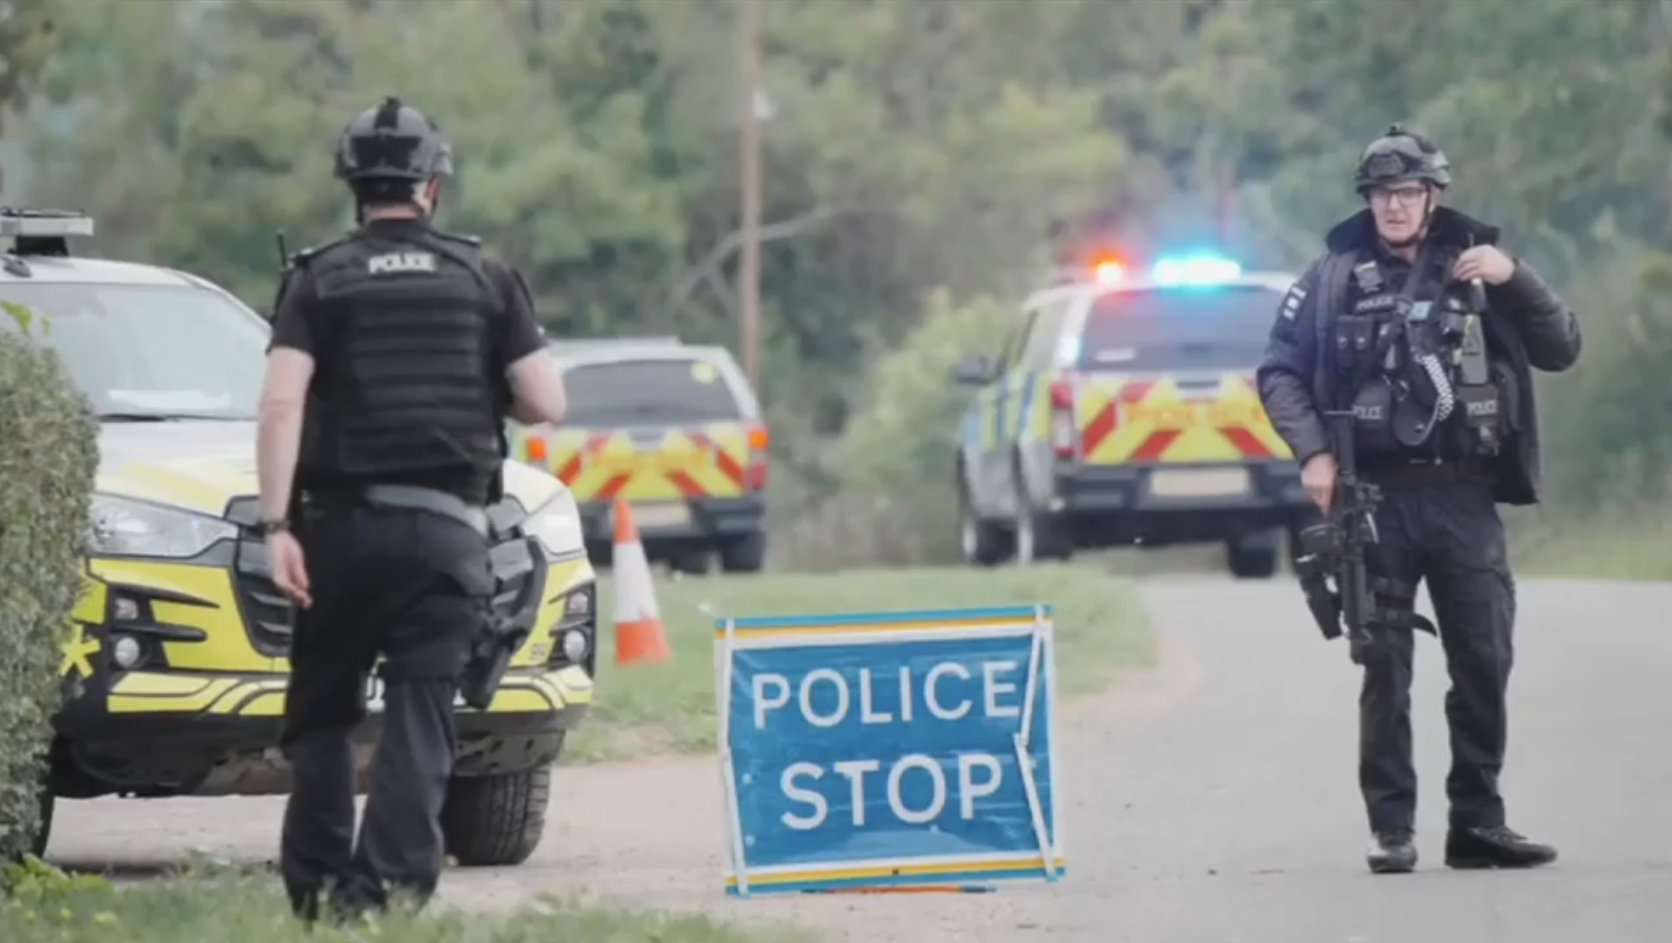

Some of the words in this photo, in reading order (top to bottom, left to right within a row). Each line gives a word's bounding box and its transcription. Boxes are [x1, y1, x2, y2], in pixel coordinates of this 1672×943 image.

[368, 252, 435, 274] POLICE
[1467, 399, 1498, 417] POLICE
[752, 660, 1021, 730] POLICE
[780, 753, 1003, 830] STOP
